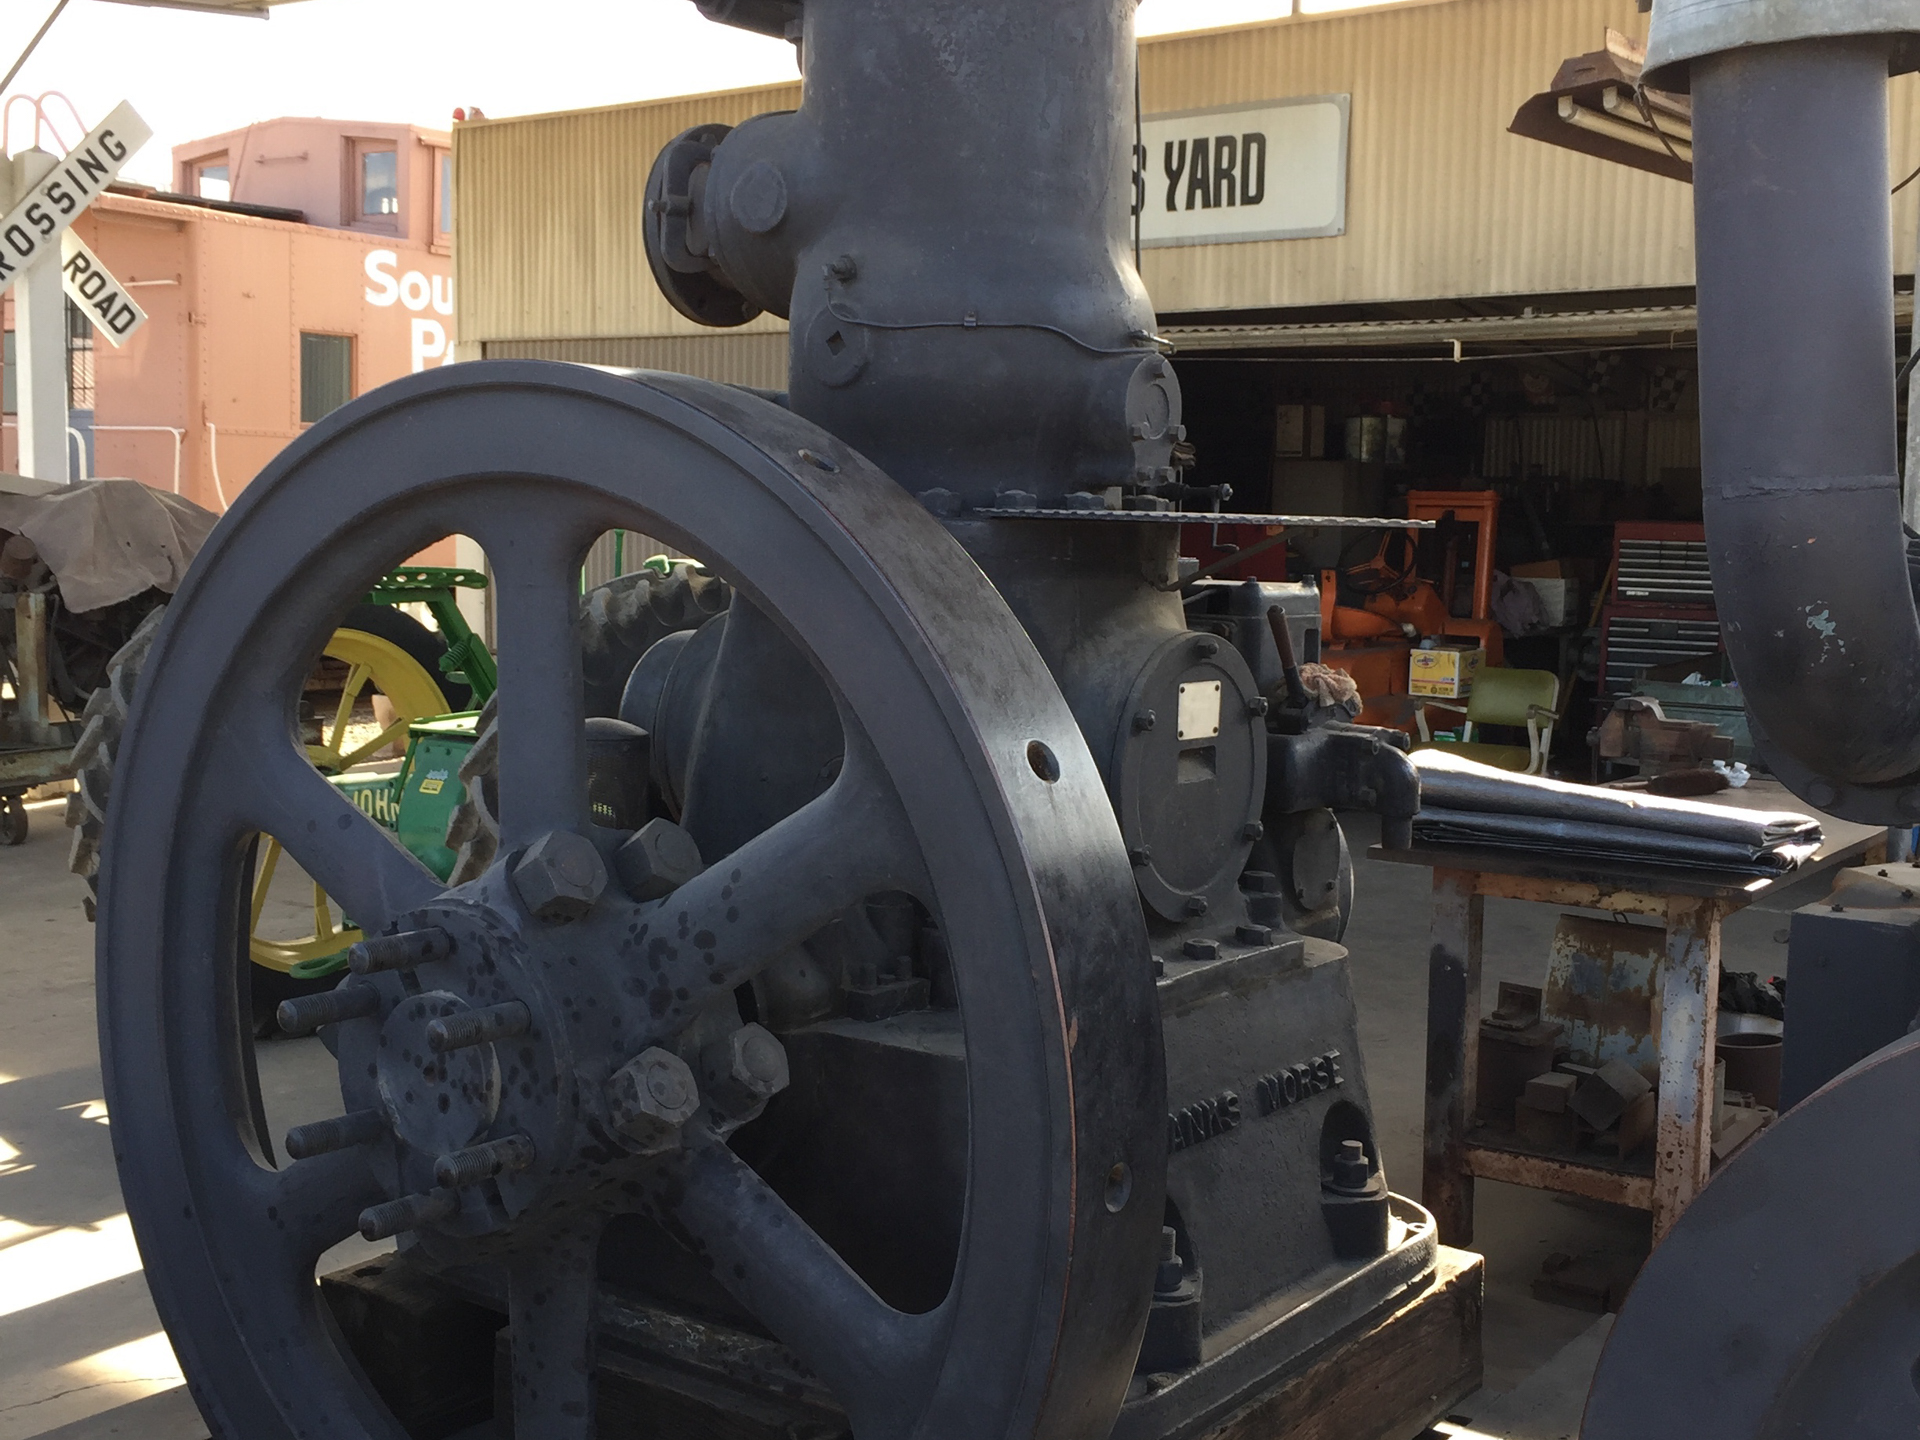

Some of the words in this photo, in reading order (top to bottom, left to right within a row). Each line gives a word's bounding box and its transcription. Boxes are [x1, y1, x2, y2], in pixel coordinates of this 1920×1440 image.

[1164, 132, 1267, 212] YARD
[63, 250, 136, 335] ROAD
[1256, 1048, 1345, 1117] MORSE
